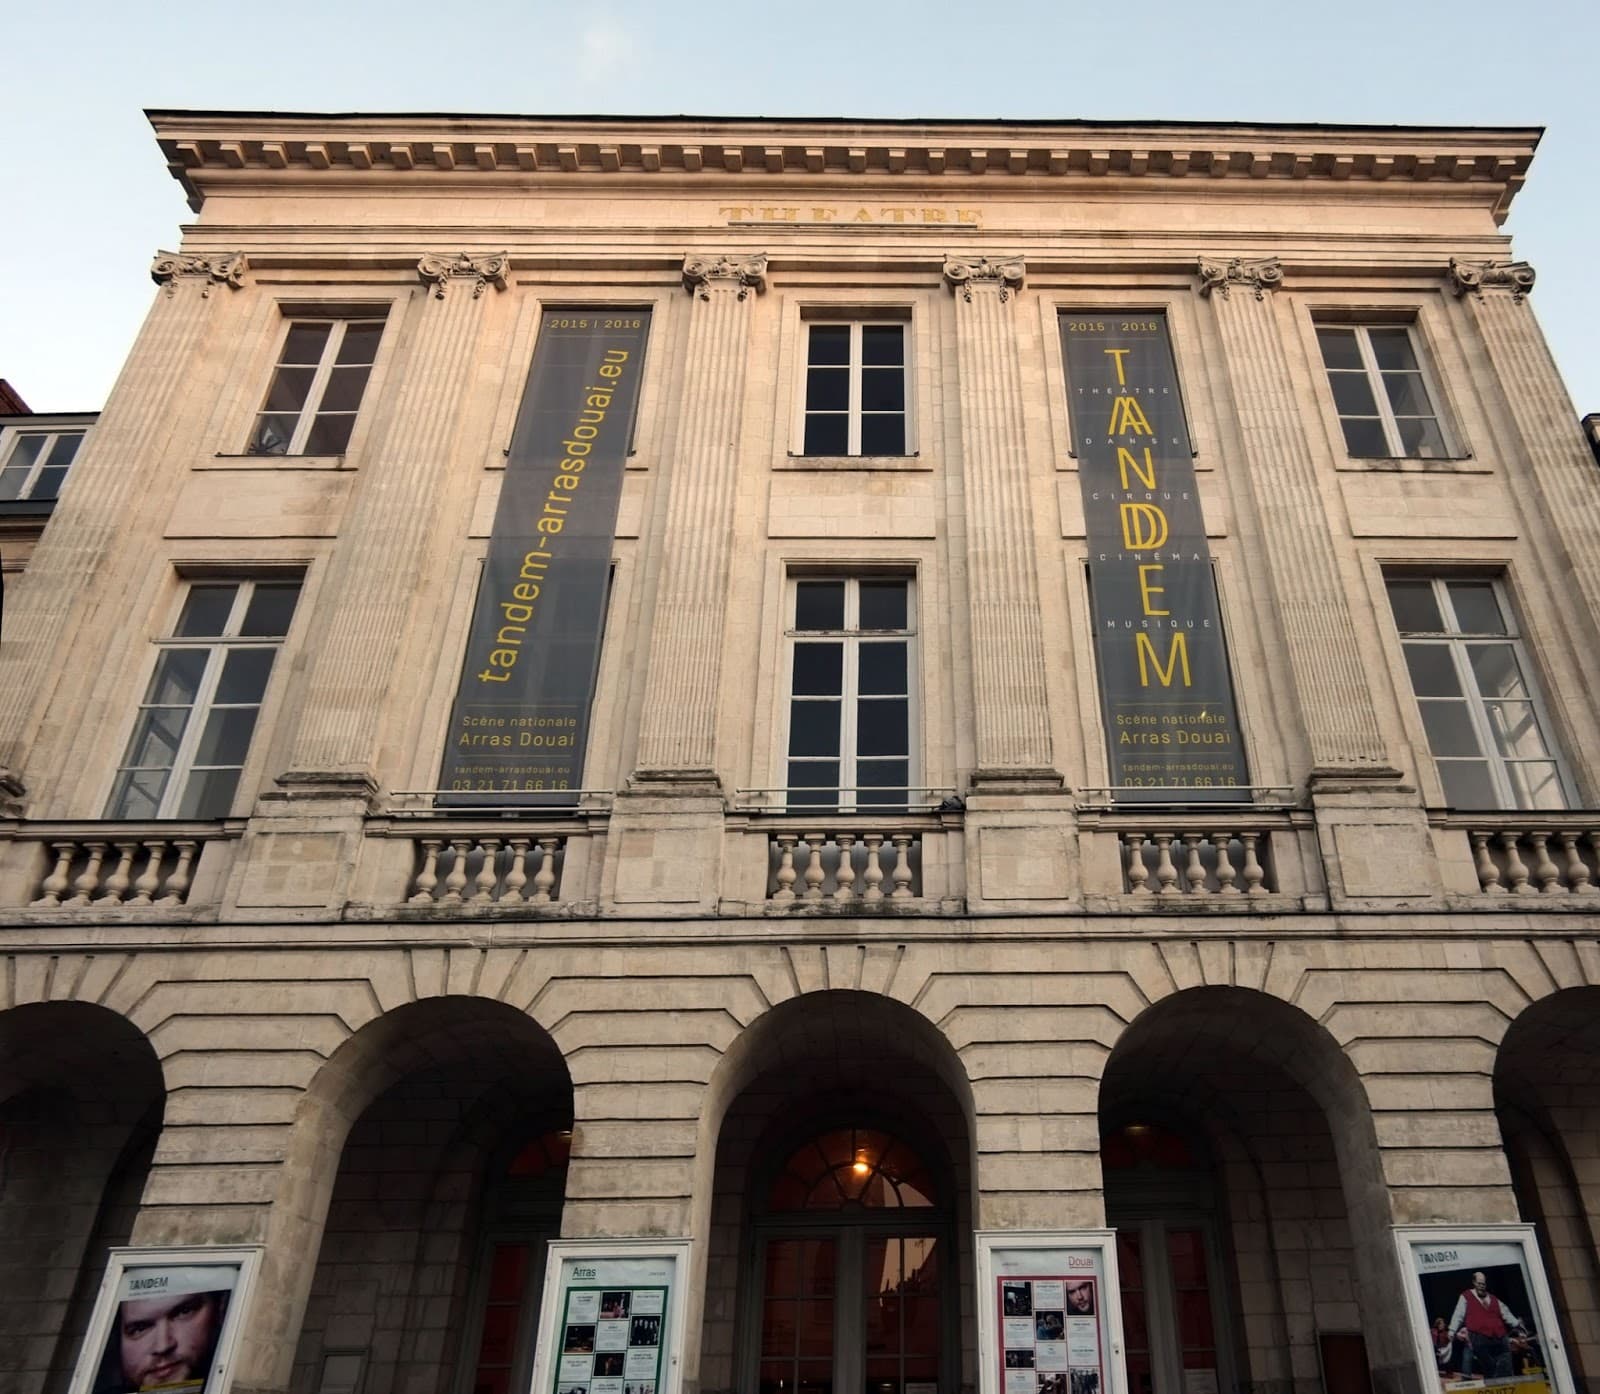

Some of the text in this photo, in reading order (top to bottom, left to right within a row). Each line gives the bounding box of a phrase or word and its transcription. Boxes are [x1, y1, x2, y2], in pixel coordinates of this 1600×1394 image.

[550, 319, 588, 329] 2015
[604, 319, 641, 329] 2016
[1121, 322, 1158, 332] 2016
[478, 349, 629, 683] tandem-arrasdouai.eu
[1106, 619, 1211, 629] MUSIQUE
[463, 716, 577, 727] Scène nationale
[1116, 711, 1226, 726] Scène nationale
[459, 732, 575, 747] Arras Douai
[1120, 729, 1233, 745] Arras Douai
[1068, 1256, 1094, 1266] Douai
[572, 1267, 597, 1277] Arras
